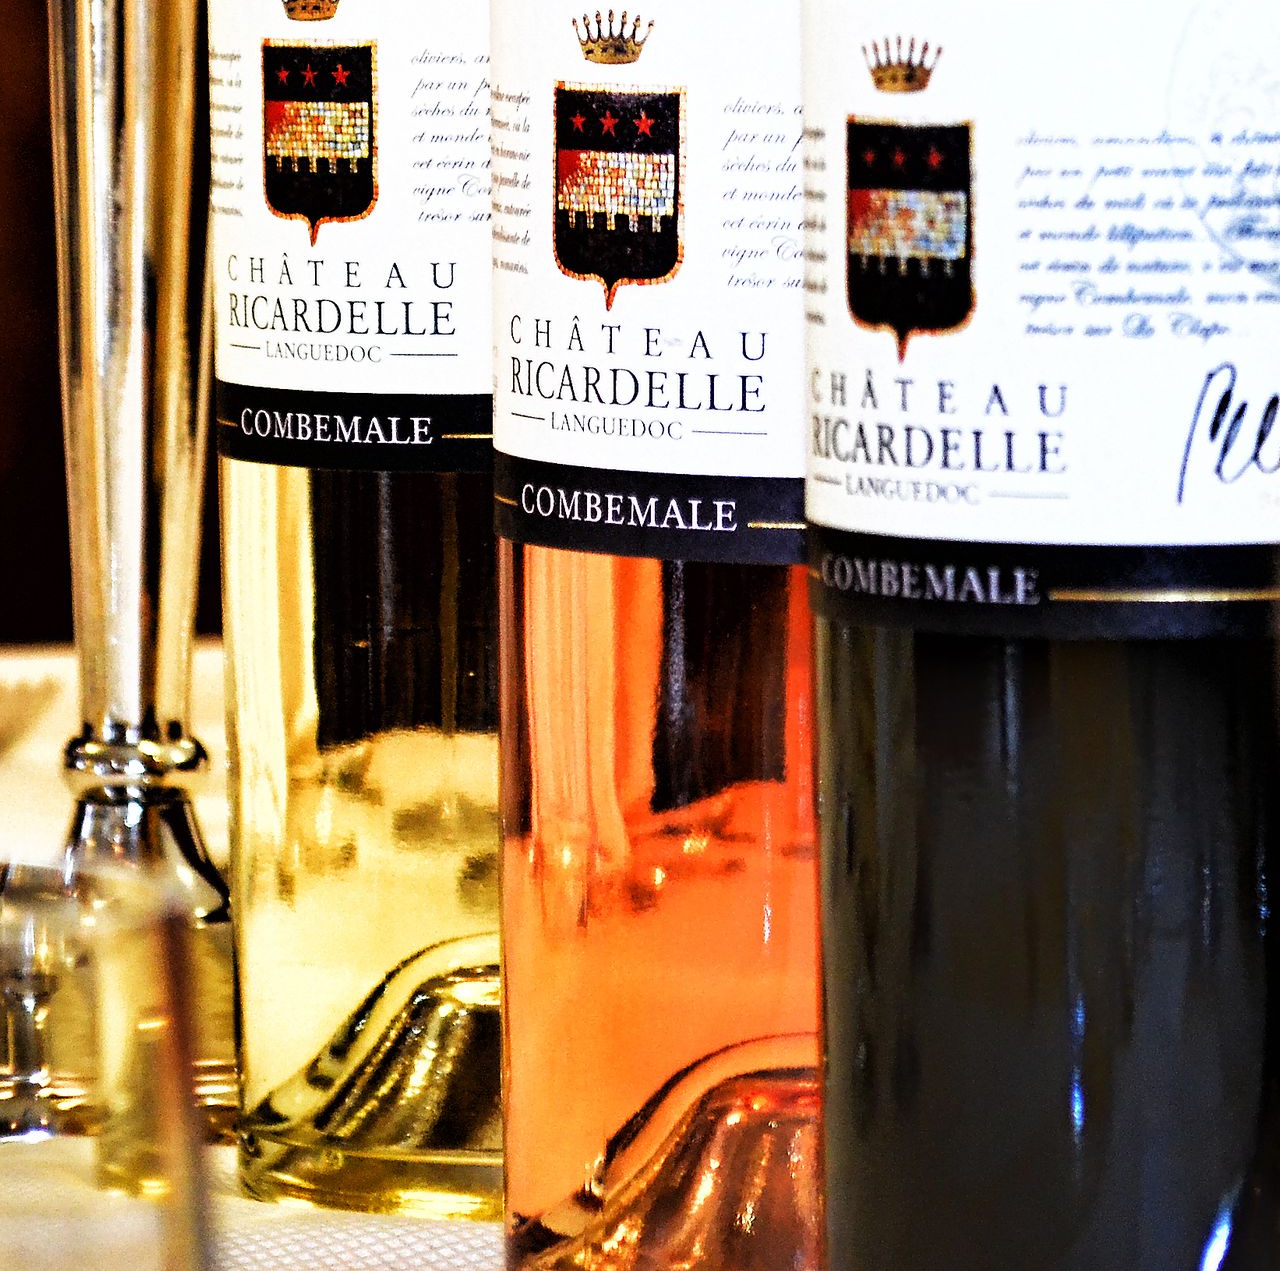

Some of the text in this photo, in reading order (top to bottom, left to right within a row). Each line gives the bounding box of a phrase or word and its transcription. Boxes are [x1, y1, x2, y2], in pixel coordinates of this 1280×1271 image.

[430, 127, 485, 144] monde
[227, 252, 457, 289] CHÂTEAU
[228, 291, 457, 336] RICARDELLE
[265, 340, 383, 363] LANGUEDOC
[510, 314, 769, 362] CHÂTEAU
[510, 356, 767, 413] RICARDELLE
[810, 367, 1068, 418] CHÂTEAU
[240, 407, 434, 446] COMBEMALE
[551, 411, 684, 441] LANGUEDOC
[812, 414, 1069, 474] RICARDELLE
[521, 483, 739, 533] COMBEMALE
[845, 473, 981, 506] LANGUEDOC
[820, 552, 1041, 606] COMBEMALE
